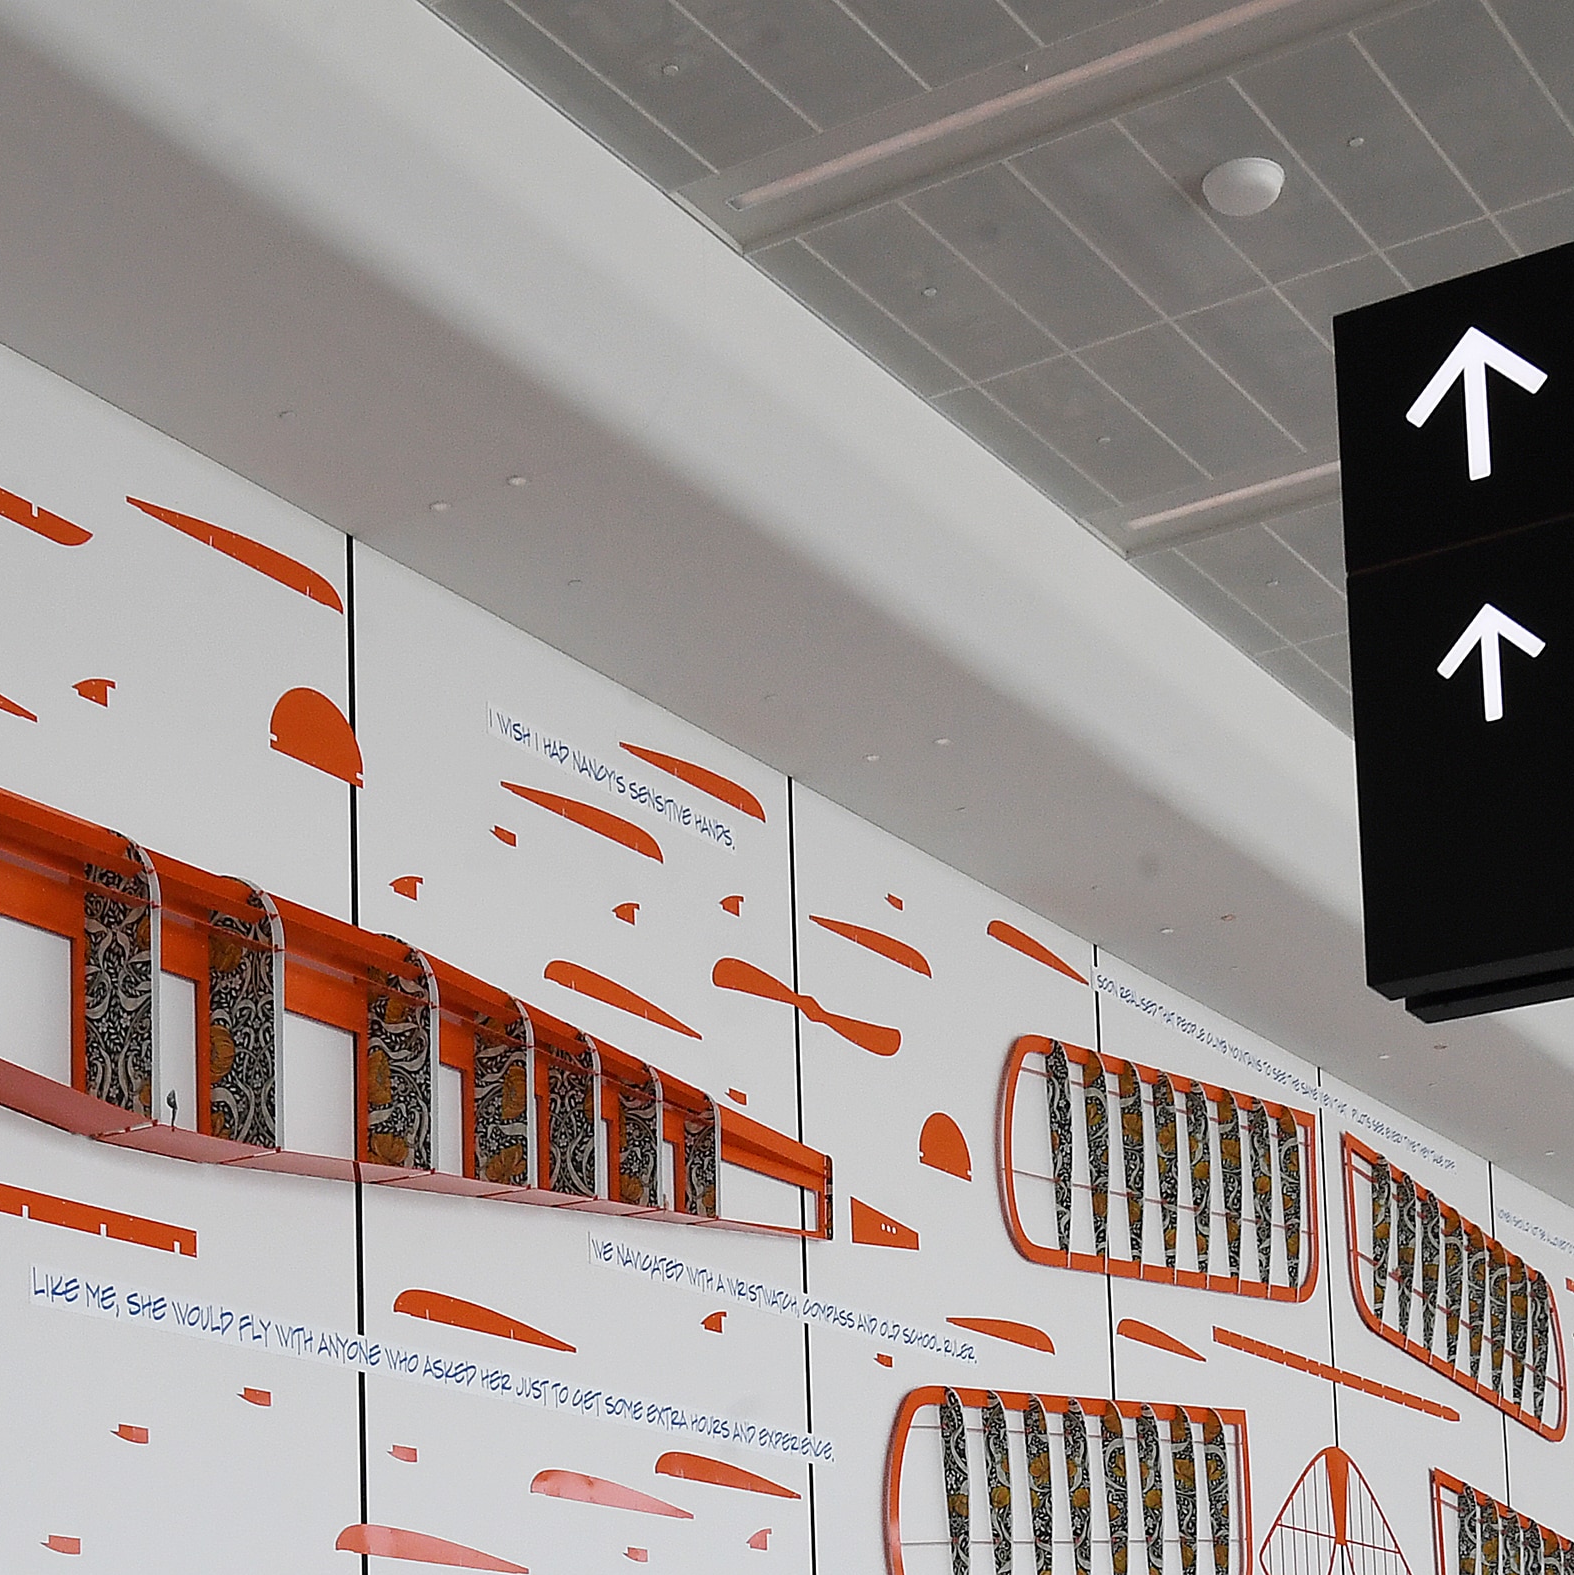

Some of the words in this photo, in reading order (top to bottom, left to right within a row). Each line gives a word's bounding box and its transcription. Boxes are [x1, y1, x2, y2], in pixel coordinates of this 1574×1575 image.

[496, 710, 532, 748] WISH
[543, 737, 570, 765] HAD
[628, 781, 692, 826] SENSITIVE
[693, 813, 736, 851] HANDS.
[32, 1266, 80, 1303] LIKE
[85, 1281, 120, 1318] ME,
[126, 1292, 168, 1321] SHE
[171, 1300, 234, 1335] WOULD
[238, 1314, 271, 1348] FLY
[274, 1323, 314, 1356] WITH
[317, 1332, 382, 1366] ANYONE
[384, 1347, 419, 1374] WHO
[422, 1355, 477, 1387] ASKED
[480, 1369, 512, 1396] HER
[516, 1376, 550, 1407] JUST
[551, 1382, 569, 1409] TO
[572, 1388, 602, 1417] GET
[604, 1395, 644, 1420] SOME
[646, 1403, 689, 1431] EXTRA
[690, 1413, 730, 1440] HOURS
[732, 1421, 756, 1445] AND
[616, 1243, 684, 1283] NAVIGATED
[685, 1264, 714, 1293] WITH
[716, 1273, 725, 1294] A
[802, 1299, 855, 1330] COMPASS
[856, 1312, 878, 1336] AND
[879, 1321, 901, 1343] OLD
[902, 1327, 942, 1353] SCHOOL
